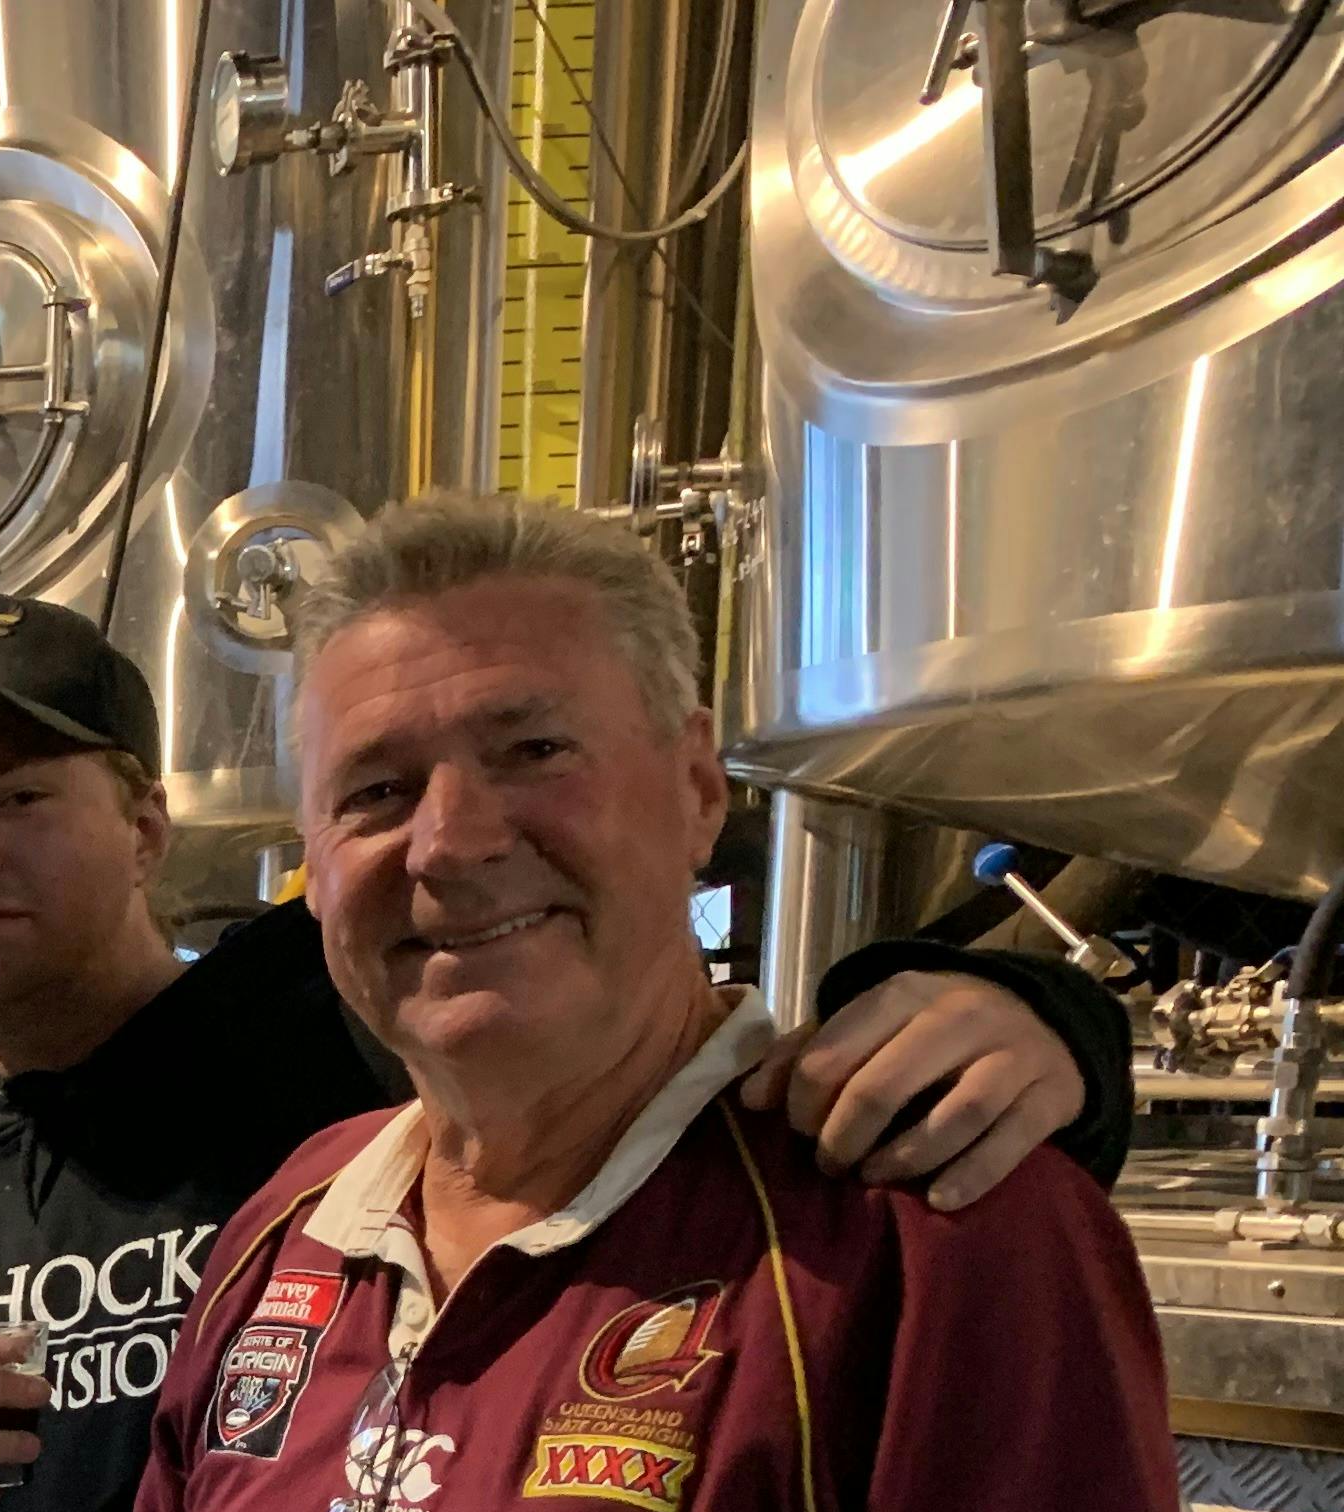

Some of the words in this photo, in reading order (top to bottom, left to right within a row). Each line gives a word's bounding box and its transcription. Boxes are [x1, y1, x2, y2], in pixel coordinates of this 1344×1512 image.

[254, 1301, 312, 1320] orman
[242, 1335, 274, 1348] STATE
[276, 1335, 295, 1349] OF
[228, 1351, 297, 1374] ORIGIN
[559, 1402, 685, 1427] QUEENSLAND
[544, 1417, 589, 1433] STATE
[591, 1420, 619, 1434] OF
[619, 1423, 694, 1448] ORIGIN
[538, 1444, 682, 1499] XXXX
